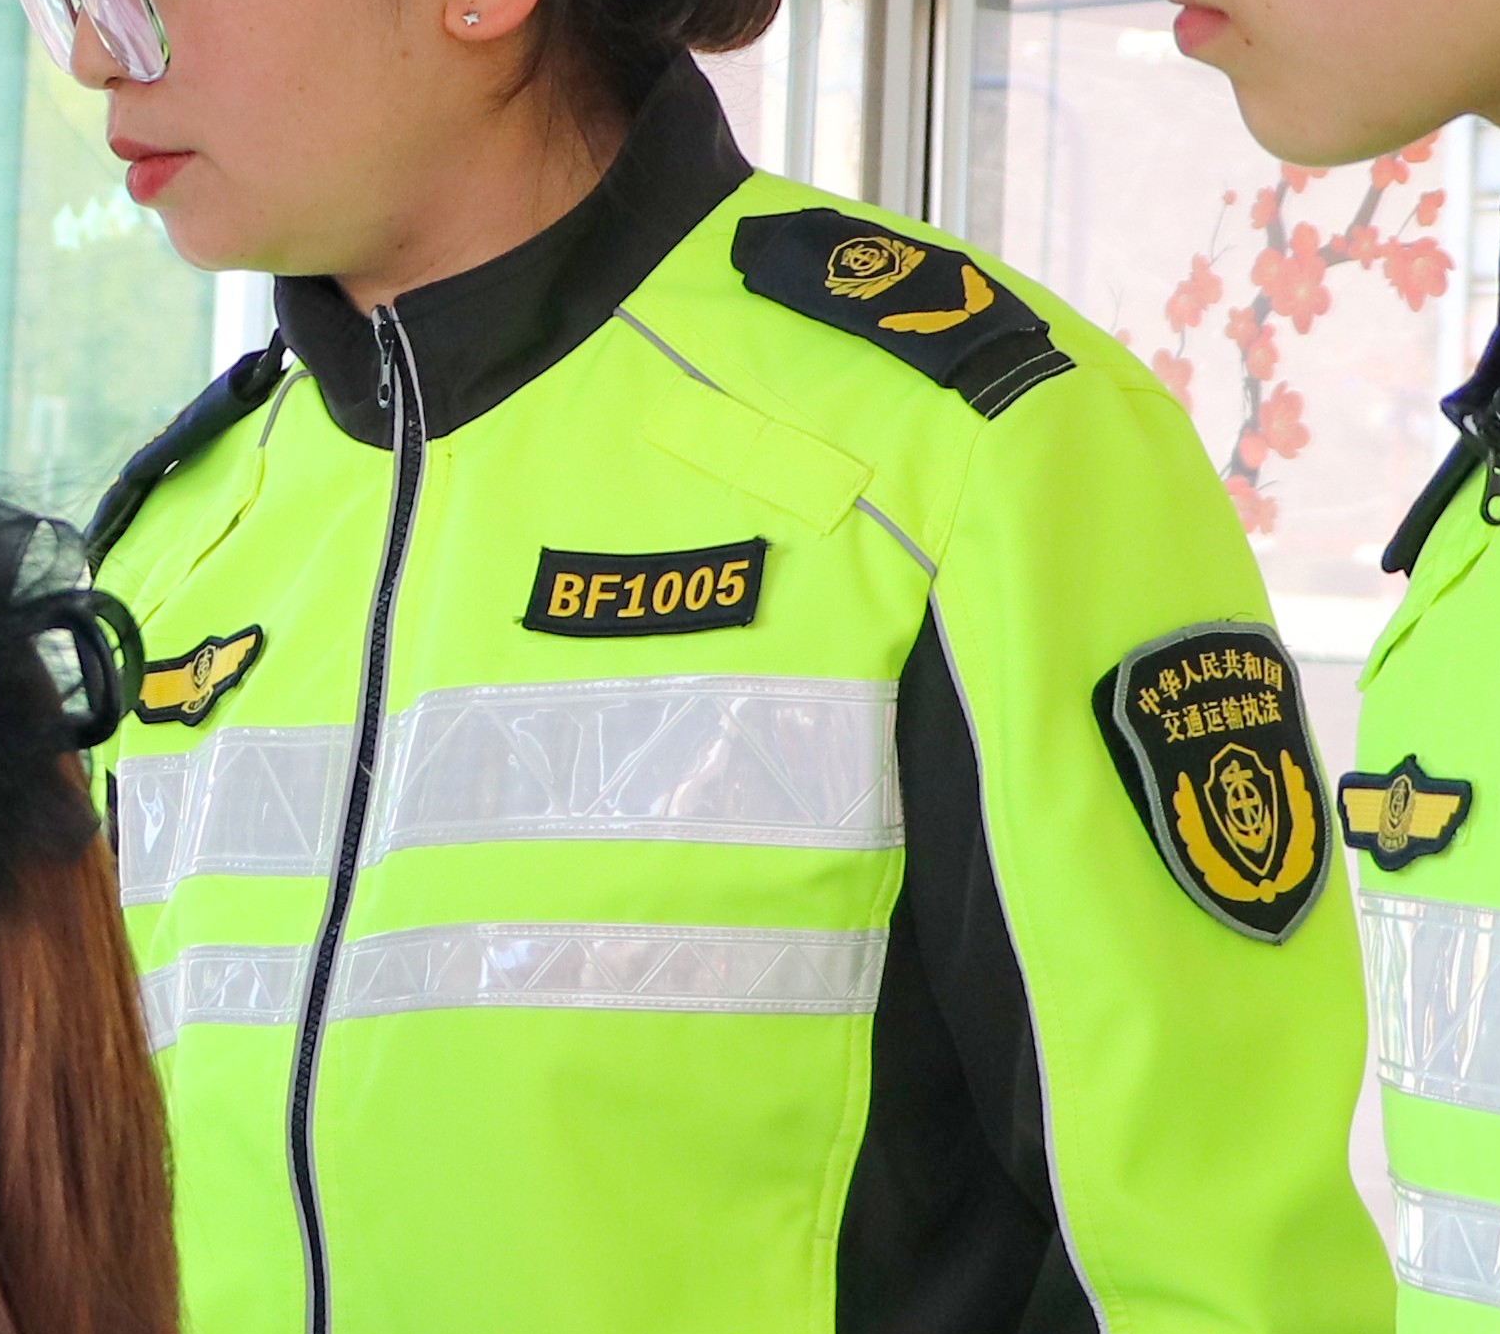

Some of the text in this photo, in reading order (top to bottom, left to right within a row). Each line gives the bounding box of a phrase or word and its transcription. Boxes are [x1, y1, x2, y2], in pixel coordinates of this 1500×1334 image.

[547, 560, 751, 620] BF1005
[1138, 649, 1284, 717] 中华人民共和国
[1161, 691, 1282, 743] 交通运输执法
